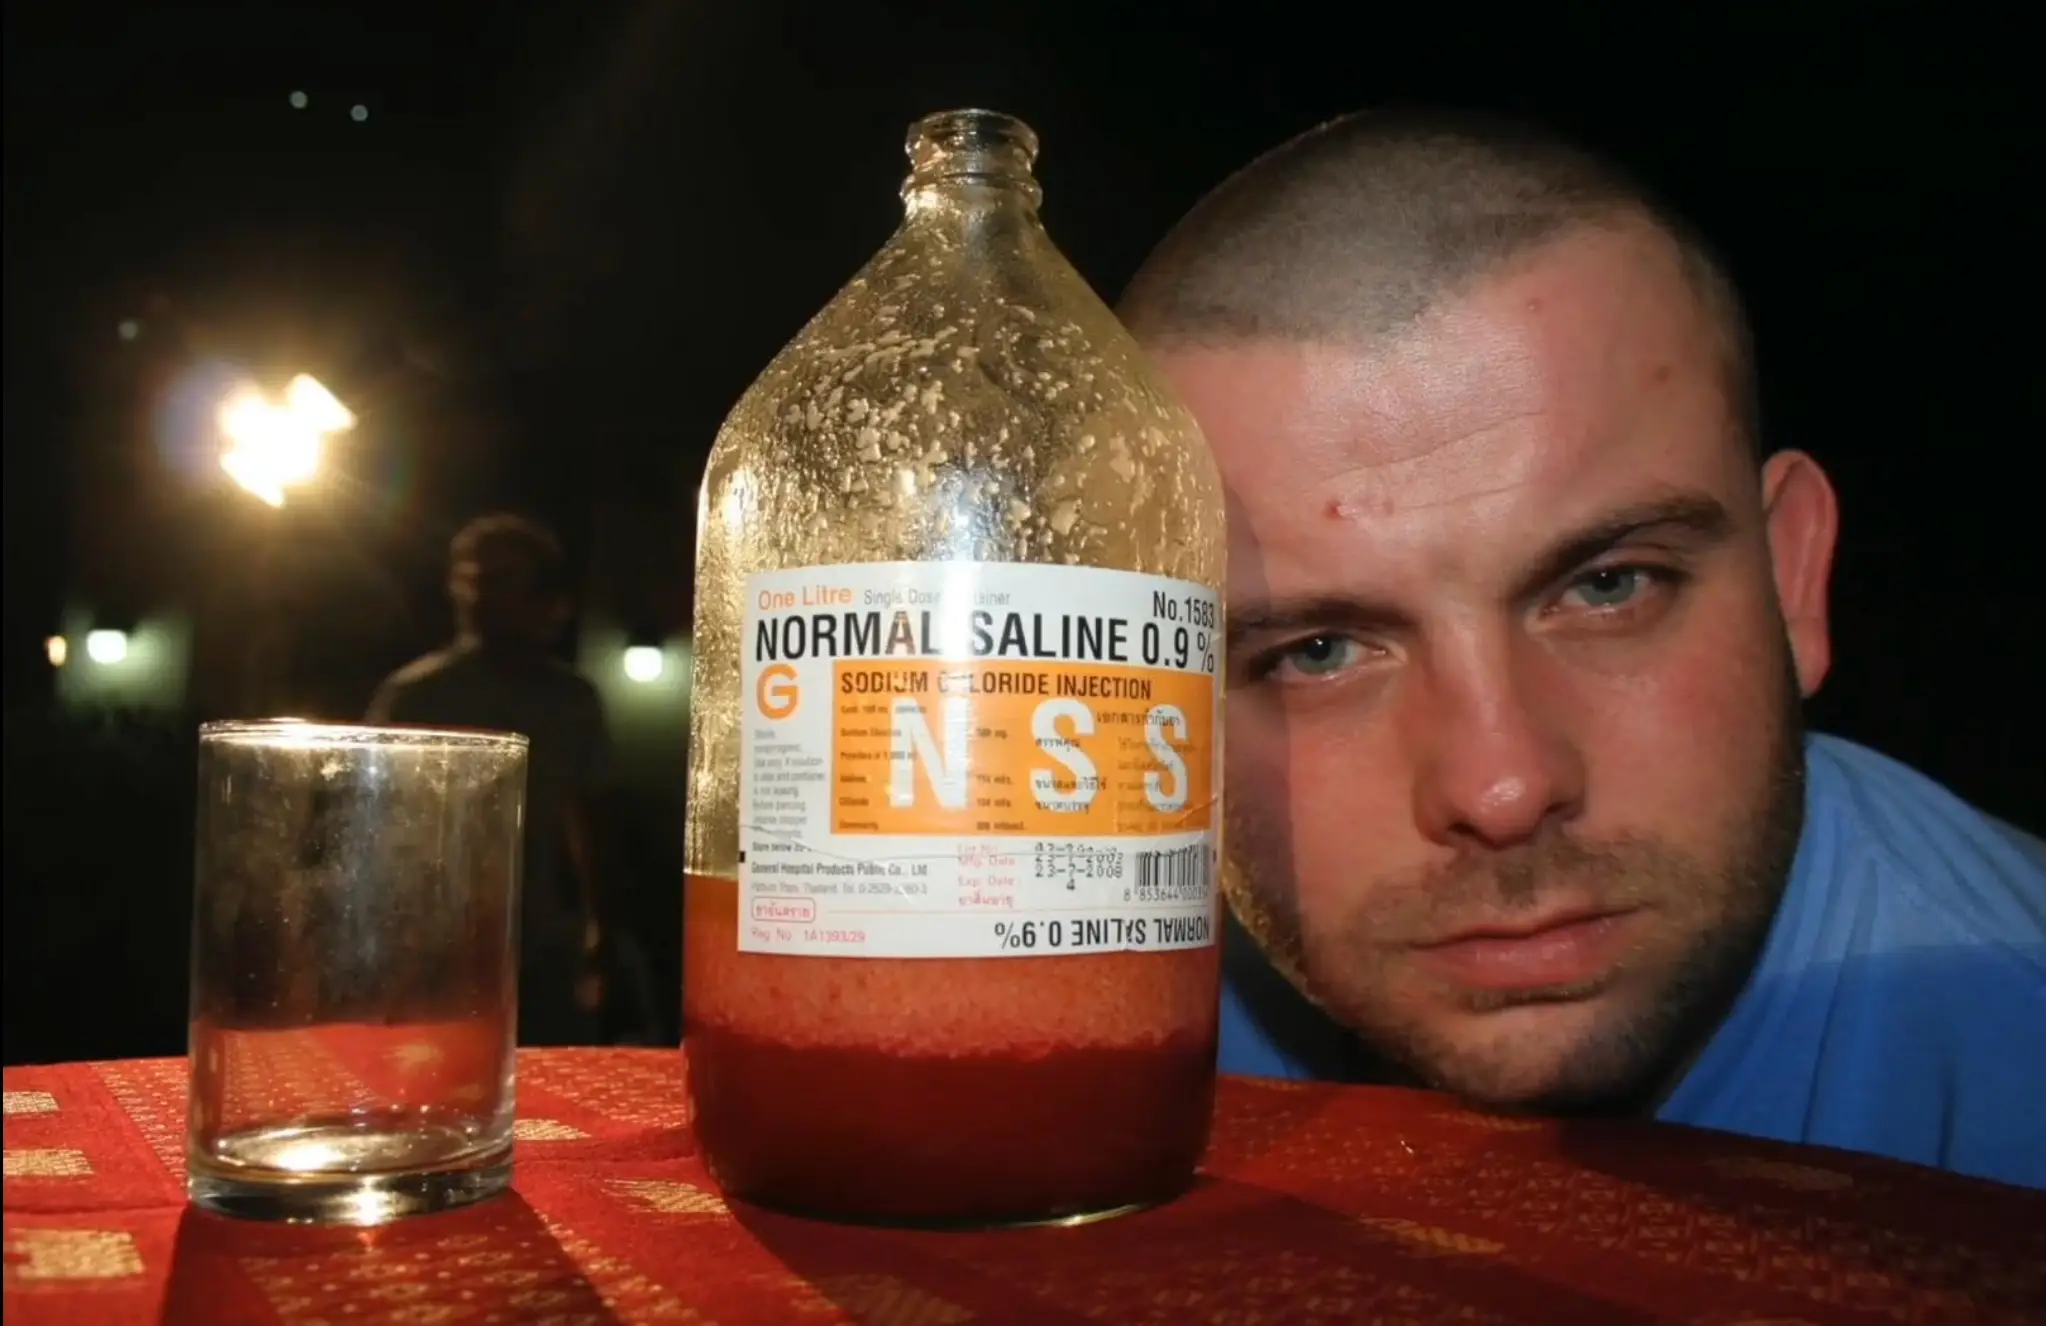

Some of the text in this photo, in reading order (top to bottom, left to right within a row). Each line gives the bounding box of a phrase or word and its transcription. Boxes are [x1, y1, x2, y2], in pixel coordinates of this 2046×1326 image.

[758, 584, 853, 610] One Litre
[864, 589, 903, 608] Single
[756, 610, 1214, 673] NORMAL SALINE 0.9 %
[756, 663, 800, 720] G
[841, 670, 1152, 700] SODIUM CLORIDE INJECTION
[1153, 915, 1210, 943] NORMAL
